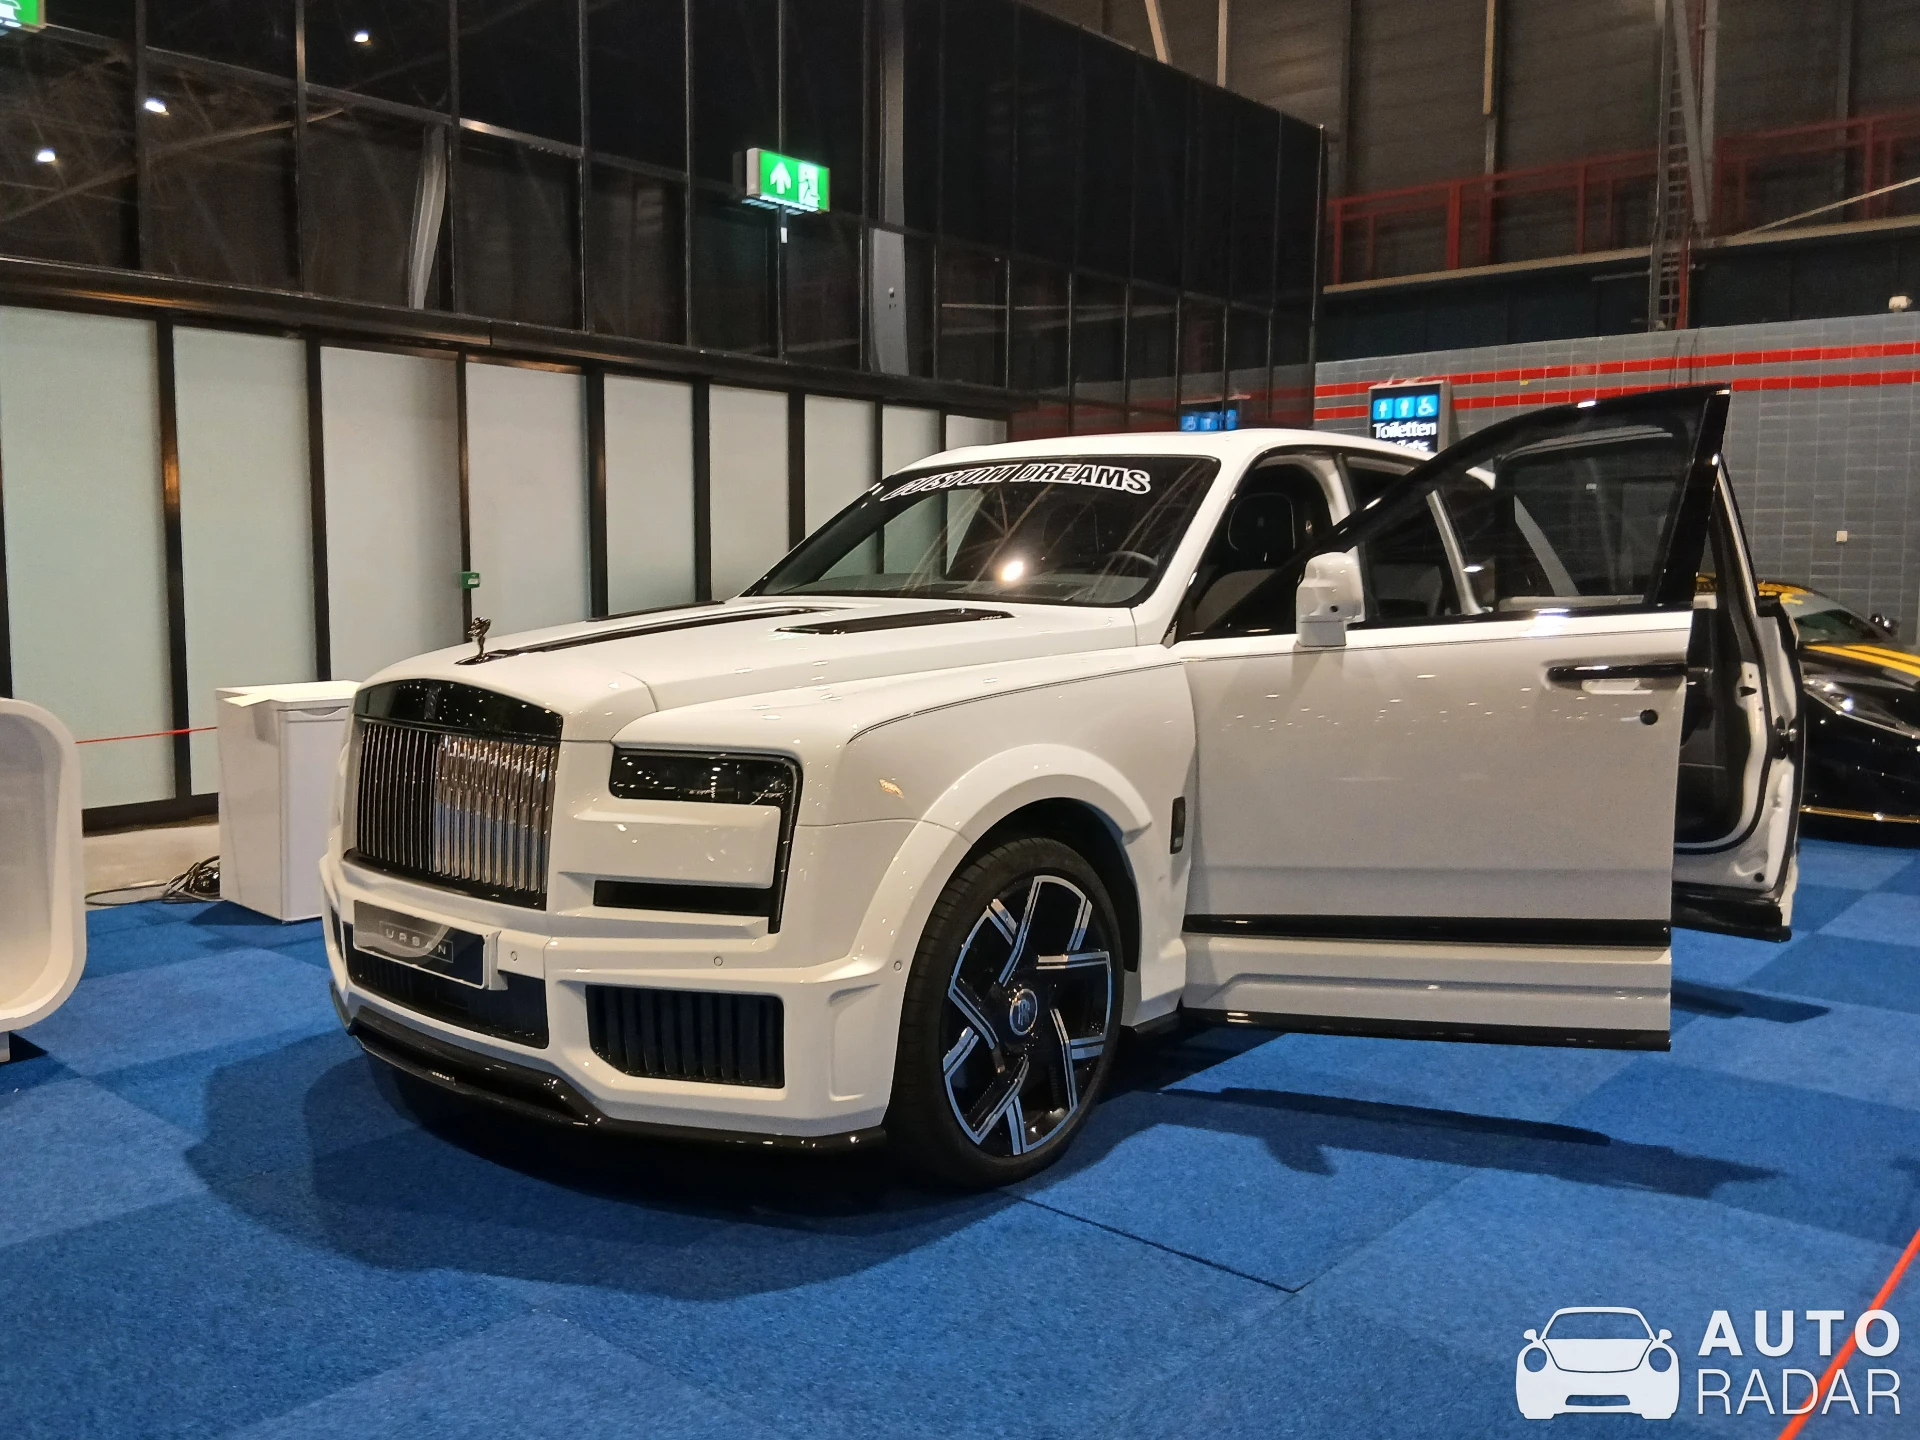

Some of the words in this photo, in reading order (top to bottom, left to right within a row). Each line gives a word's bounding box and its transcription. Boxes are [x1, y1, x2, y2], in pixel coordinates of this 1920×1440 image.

[1372, 421, 1437, 439] Toiletten
[880, 464, 1020, 501] CUSTOM
[1010, 462, 1151, 494] DREAMS
